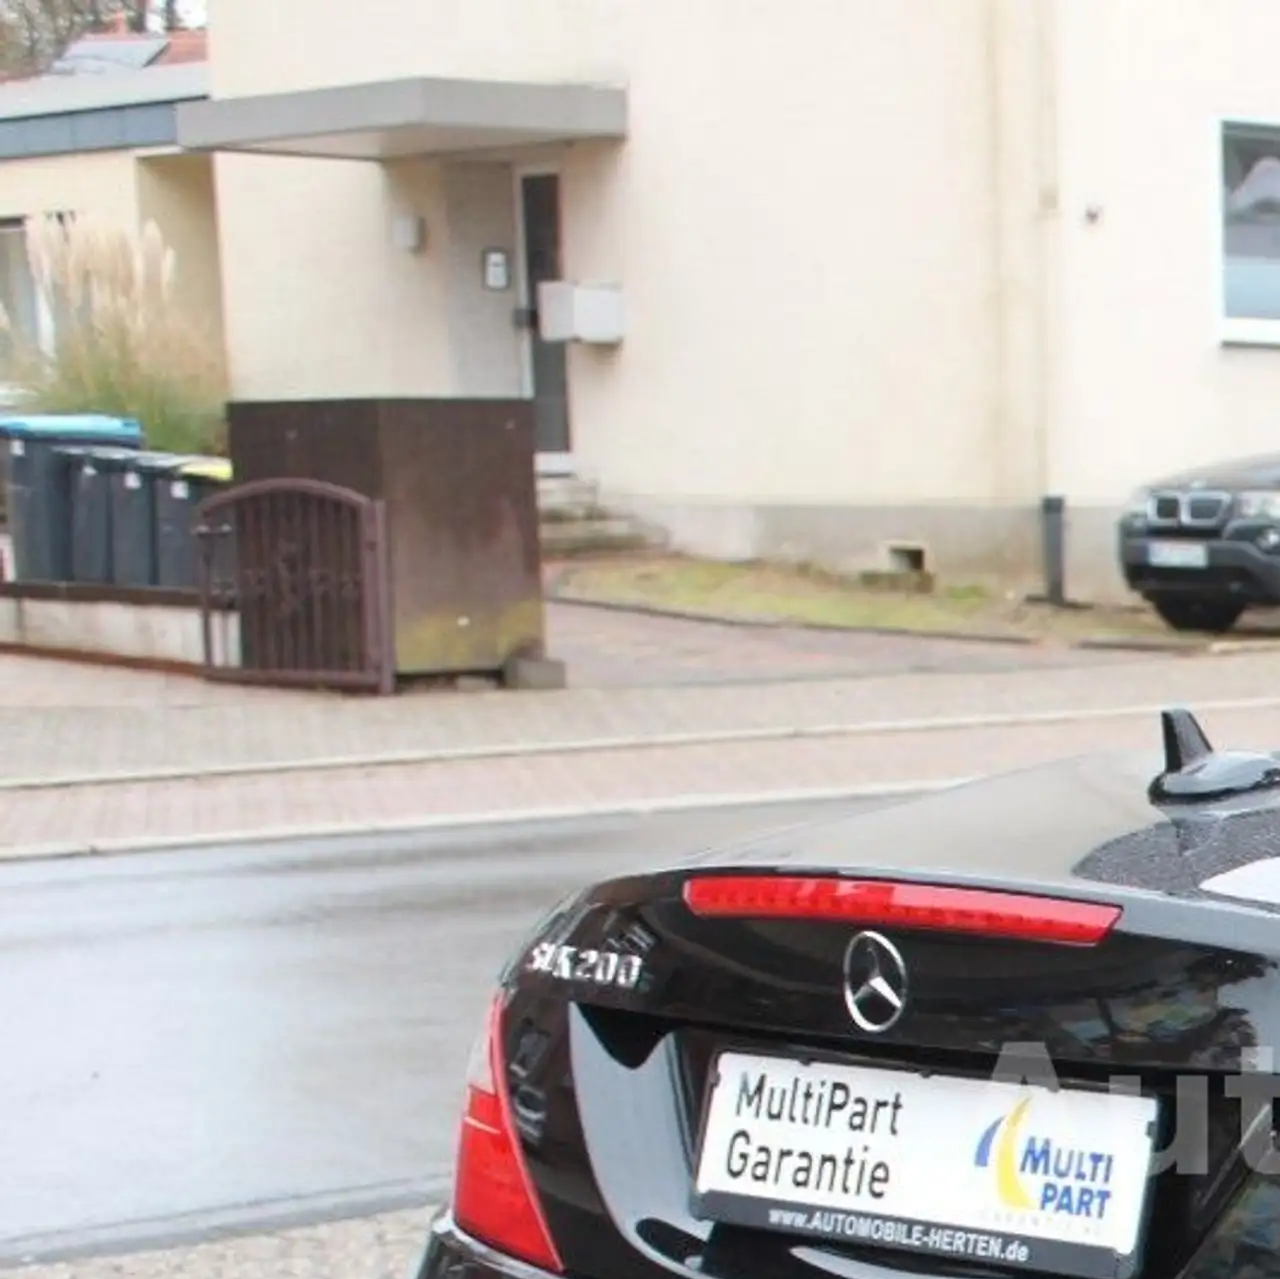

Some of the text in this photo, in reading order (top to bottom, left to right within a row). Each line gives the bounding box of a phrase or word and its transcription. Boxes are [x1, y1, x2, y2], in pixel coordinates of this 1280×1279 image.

[735, 1071, 904, 1136] MultiPart
[726, 1128, 890, 1199] Garantie
[1019, 1135, 1114, 1184] MULTI
[1039, 1181, 1112, 1220] PART
[768, 1208, 1029, 1262] www.AUTOMOBILE-HERTEN.de
